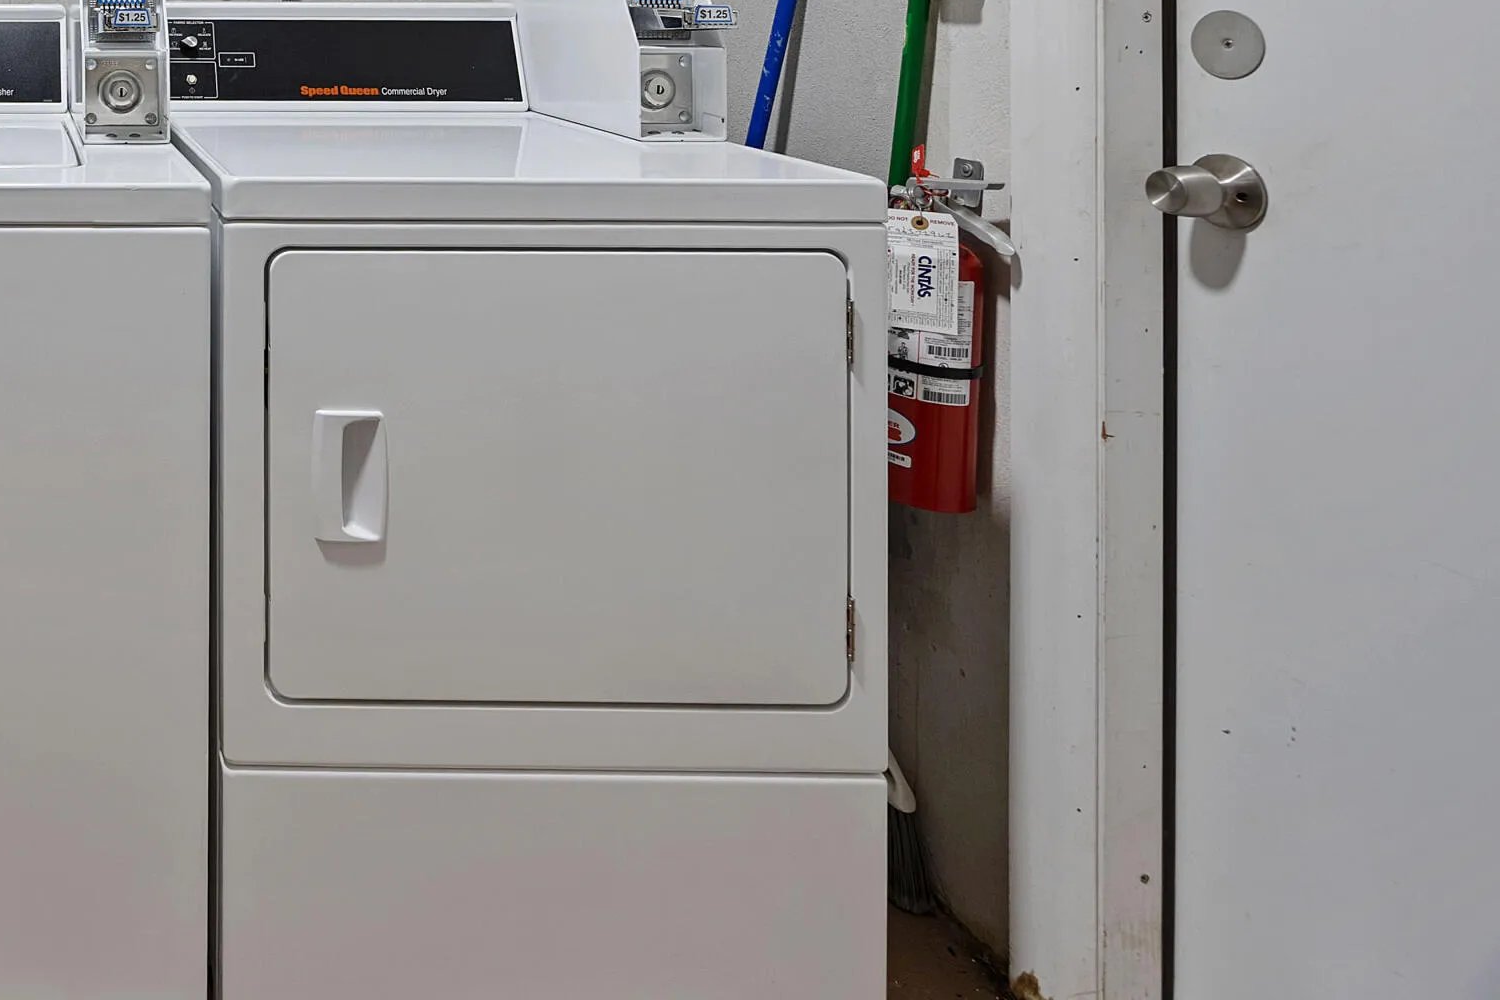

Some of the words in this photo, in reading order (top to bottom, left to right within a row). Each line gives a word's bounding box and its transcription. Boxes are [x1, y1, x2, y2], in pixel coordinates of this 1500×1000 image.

[118, 12, 146, 23] $1.25
[699, 9, 728, 19] $1.25
[300, 85, 338, 97] Speed
[340, 86, 379, 96] Queen
[381, 87, 425, 96] Commercial
[426, 87, 448, 97] Dryer
